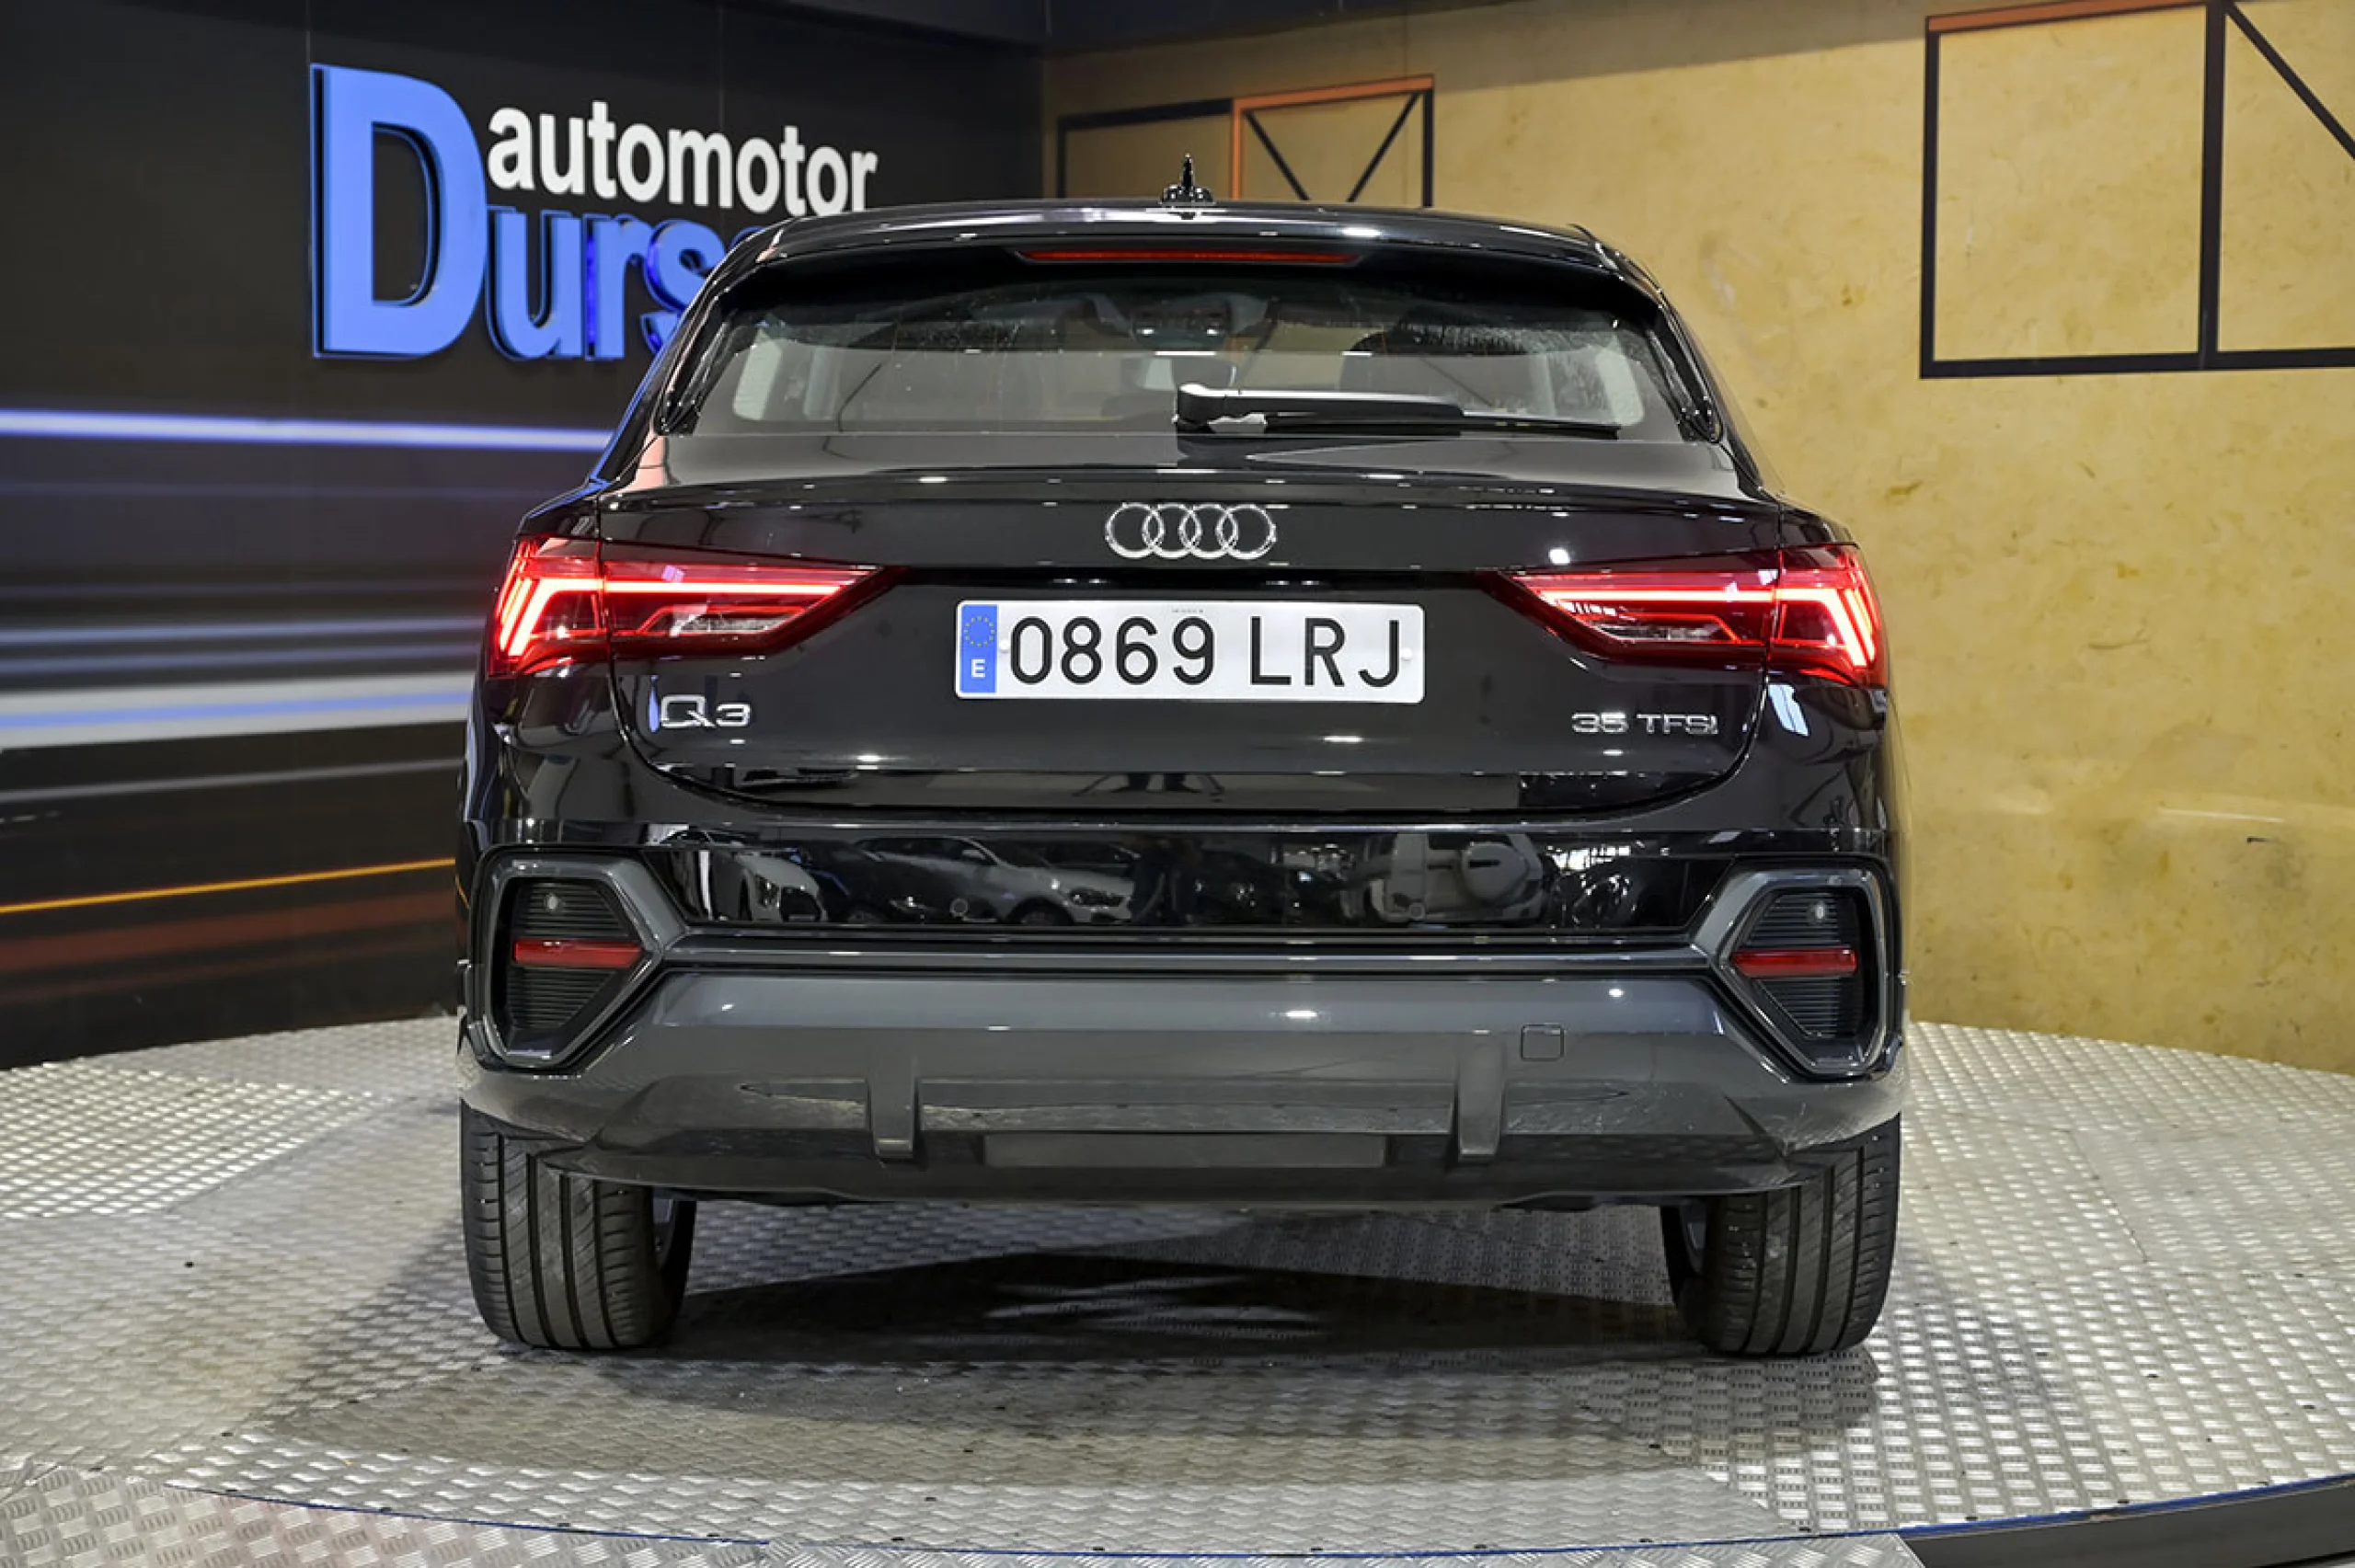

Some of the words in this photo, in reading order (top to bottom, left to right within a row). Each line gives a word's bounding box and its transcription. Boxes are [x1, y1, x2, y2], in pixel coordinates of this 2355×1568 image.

[488, 100, 879, 217] automotor
[310, 62, 765, 361] Durs
[971, 658, 986, 679] E
[1011, 615, 1214, 686] 0869
[1249, 615, 1401, 688] LRJ
[661, 693, 751, 728] Q3
[1571, 712, 1629, 734] 35
[1637, 713, 1718, 735] TFSI
